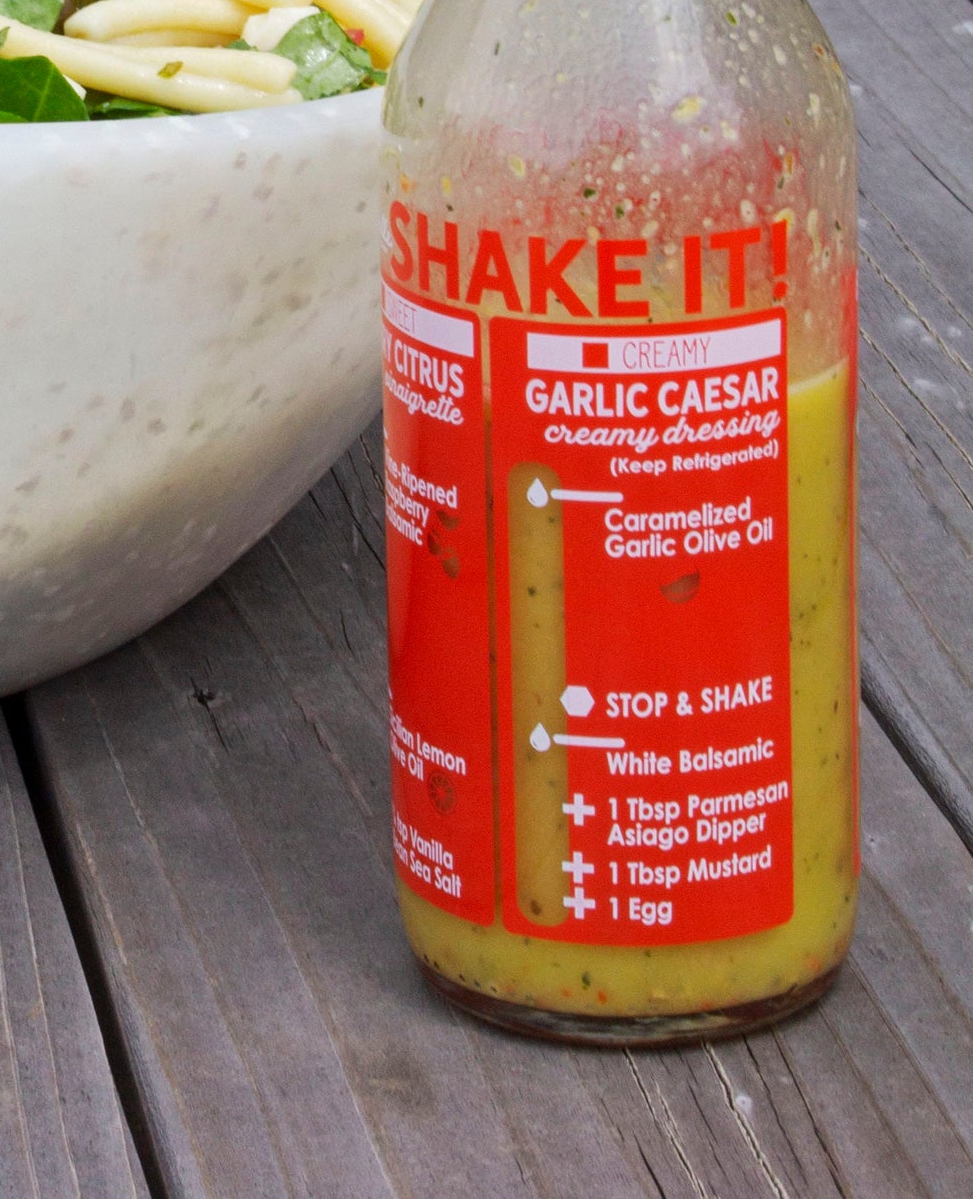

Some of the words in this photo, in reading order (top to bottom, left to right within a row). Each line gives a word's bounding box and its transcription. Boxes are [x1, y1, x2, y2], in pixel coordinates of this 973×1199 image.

[389, 200, 650, 318] SHAKE
[683, 219, 788, 314] IT!
[394, 339, 464, 398] CITRUS
[621, 336, 712, 369] CREAMY
[525, 378, 649, 418] GARLIC
[657, 366, 780, 417] CAESAR
[544, 423, 659, 453] creamy
[663, 408, 781, 445] dressing
[610, 457, 667, 477] (Keep
[672, 439, 779, 472] Refrigerated)
[604, 496, 752, 532] Caramelized
[604, 533, 676, 559] Garlic
[683, 528, 741, 555] Olive
[746, 516, 773, 545] Oil
[606, 691, 669, 718] STOP
[676, 691, 693, 717] &
[701, 675, 773, 714] SHAKE
[408, 752, 424, 781] Oil
[417, 732, 466, 776] Lemon
[606, 751, 672, 776] White
[679, 736, 774, 773] Balsamic
[609, 798, 618, 820] 1
[627, 797, 680, 825] Tbsp
[688, 780, 789, 818] Parmesan
[410, 825, 454, 871] Vanilla
[607, 822, 689, 851] Asiago
[696, 812, 767, 845] Dipper
[410, 850, 431, 884] Sea
[434, 866, 462, 898] Salt
[609, 862, 618, 885] 1
[627, 862, 681, 889] Tbsp
[687, 844, 772, 882] Mustard
[610, 897, 618, 920] 1
[629, 897, 673, 926] Egg
